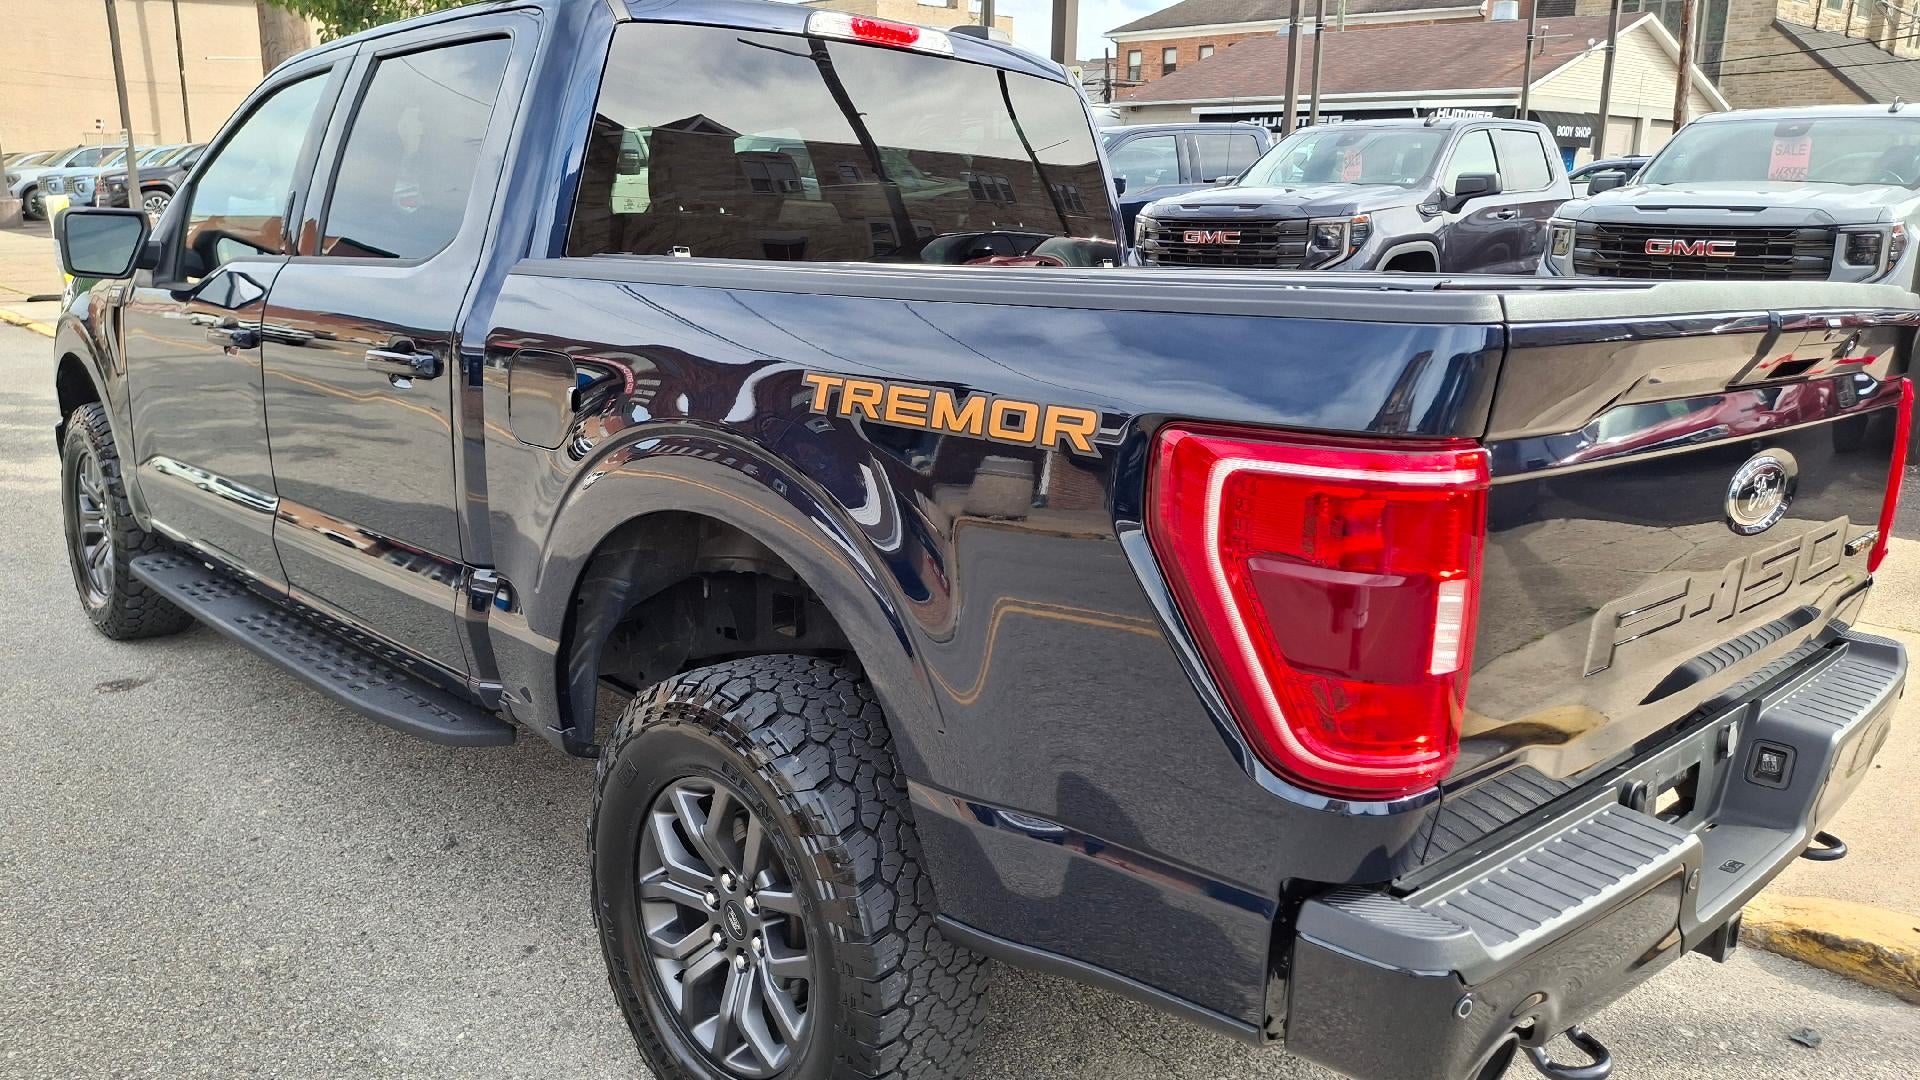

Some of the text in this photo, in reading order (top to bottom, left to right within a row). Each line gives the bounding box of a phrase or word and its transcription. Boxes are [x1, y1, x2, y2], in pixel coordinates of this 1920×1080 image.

[1556, 125, 1592, 138] BODY SHOP
[1775, 143, 1808, 156] SALE
[1183, 230, 1241, 244] GMC
[1644, 238, 1737, 257] GMC
[802, 370, 1101, 457] TREMOR
[1583, 514, 1850, 678] F-150
